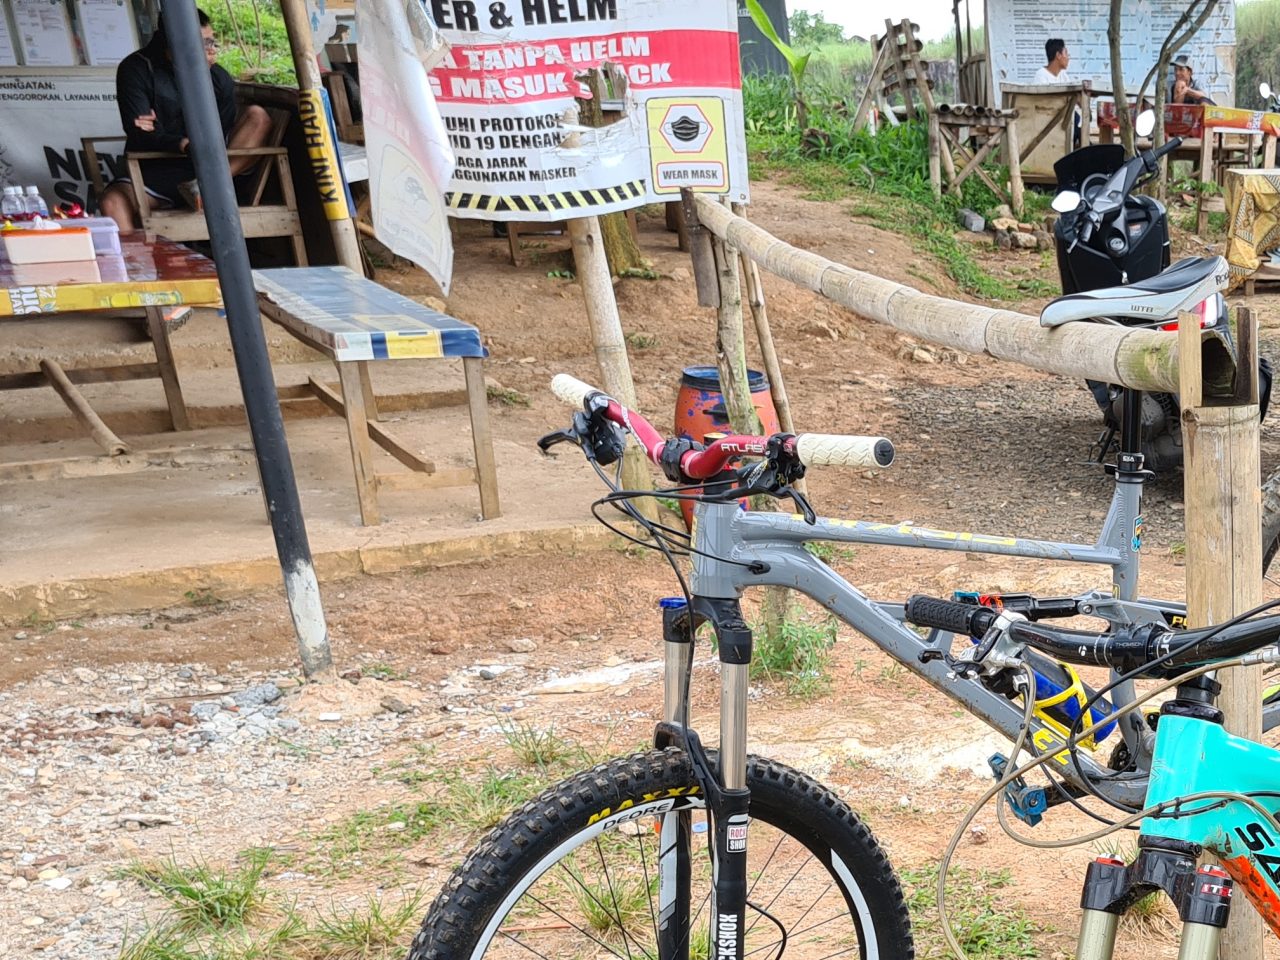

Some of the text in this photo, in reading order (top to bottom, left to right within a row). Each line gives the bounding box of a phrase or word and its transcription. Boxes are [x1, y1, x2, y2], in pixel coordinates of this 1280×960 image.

[489, 0, 514, 29] &
[521, 0, 618, 26] HELM
[462, 43, 565, 72] TANPA
[570, 36, 651, 62] HELM
[450, 71, 568, 100] MASUK
[443, 114, 477, 133] UHI
[475, 136, 496, 150] 19
[455, 156, 528, 169] AGA JARAK
[452, 166, 577, 182] GGUNAKAN MASKER
[662, 169, 718, 180] WEAR MASK
[602, 802, 671, 831] DEORE
